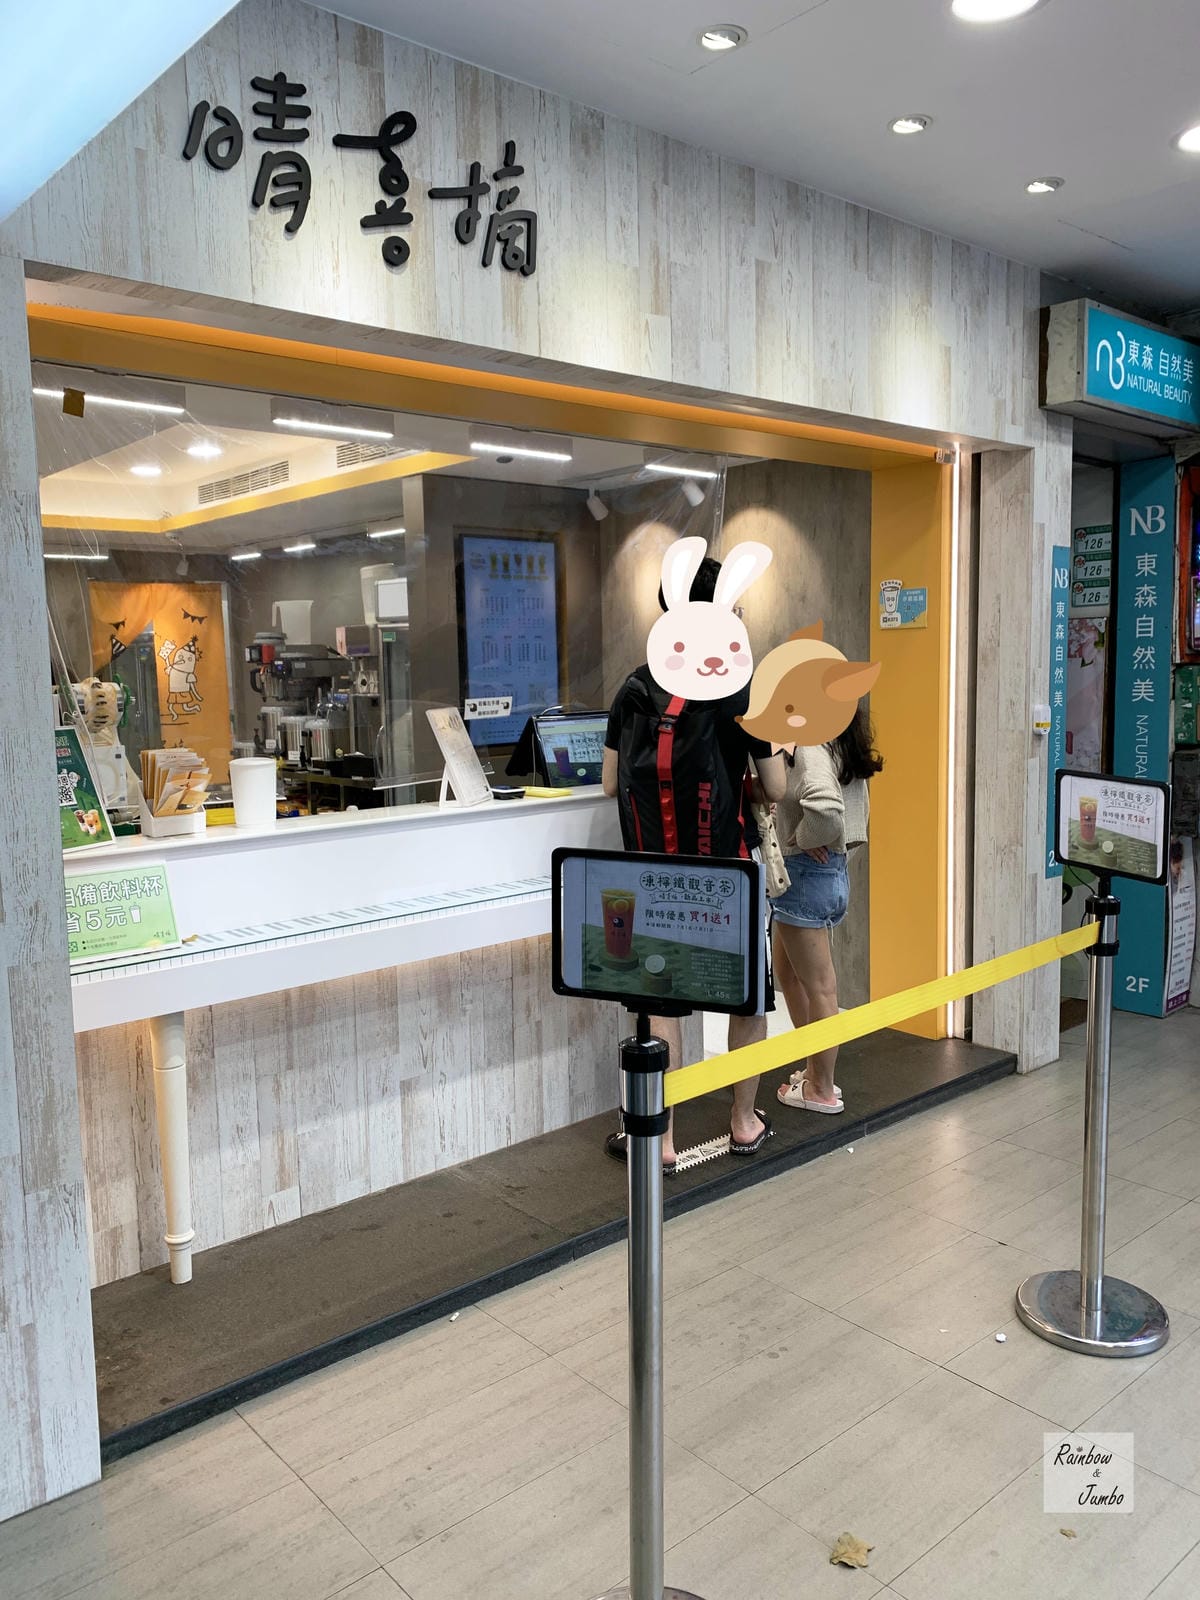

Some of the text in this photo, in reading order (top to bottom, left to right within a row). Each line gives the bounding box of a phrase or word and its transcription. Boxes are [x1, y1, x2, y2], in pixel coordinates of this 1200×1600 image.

[1127, 339, 1194, 384] 東森 自然美
[1127, 373, 1193, 405] NATURAL BEAUTY
[1129, 504, 1166, 536] NB
[1085, 538, 1103, 550] 126
[1054, 567, 1068, 589] NB
[1084, 565, 1102, 577] 126
[1082, 592, 1101, 604] 126
[1131, 552, 1158, 703] 東森自然美
[1054, 601, 1065, 707] 東森自然美
[690, 910, 731, 925] 買1送1
[1125, 975, 1150, 993] 2F
